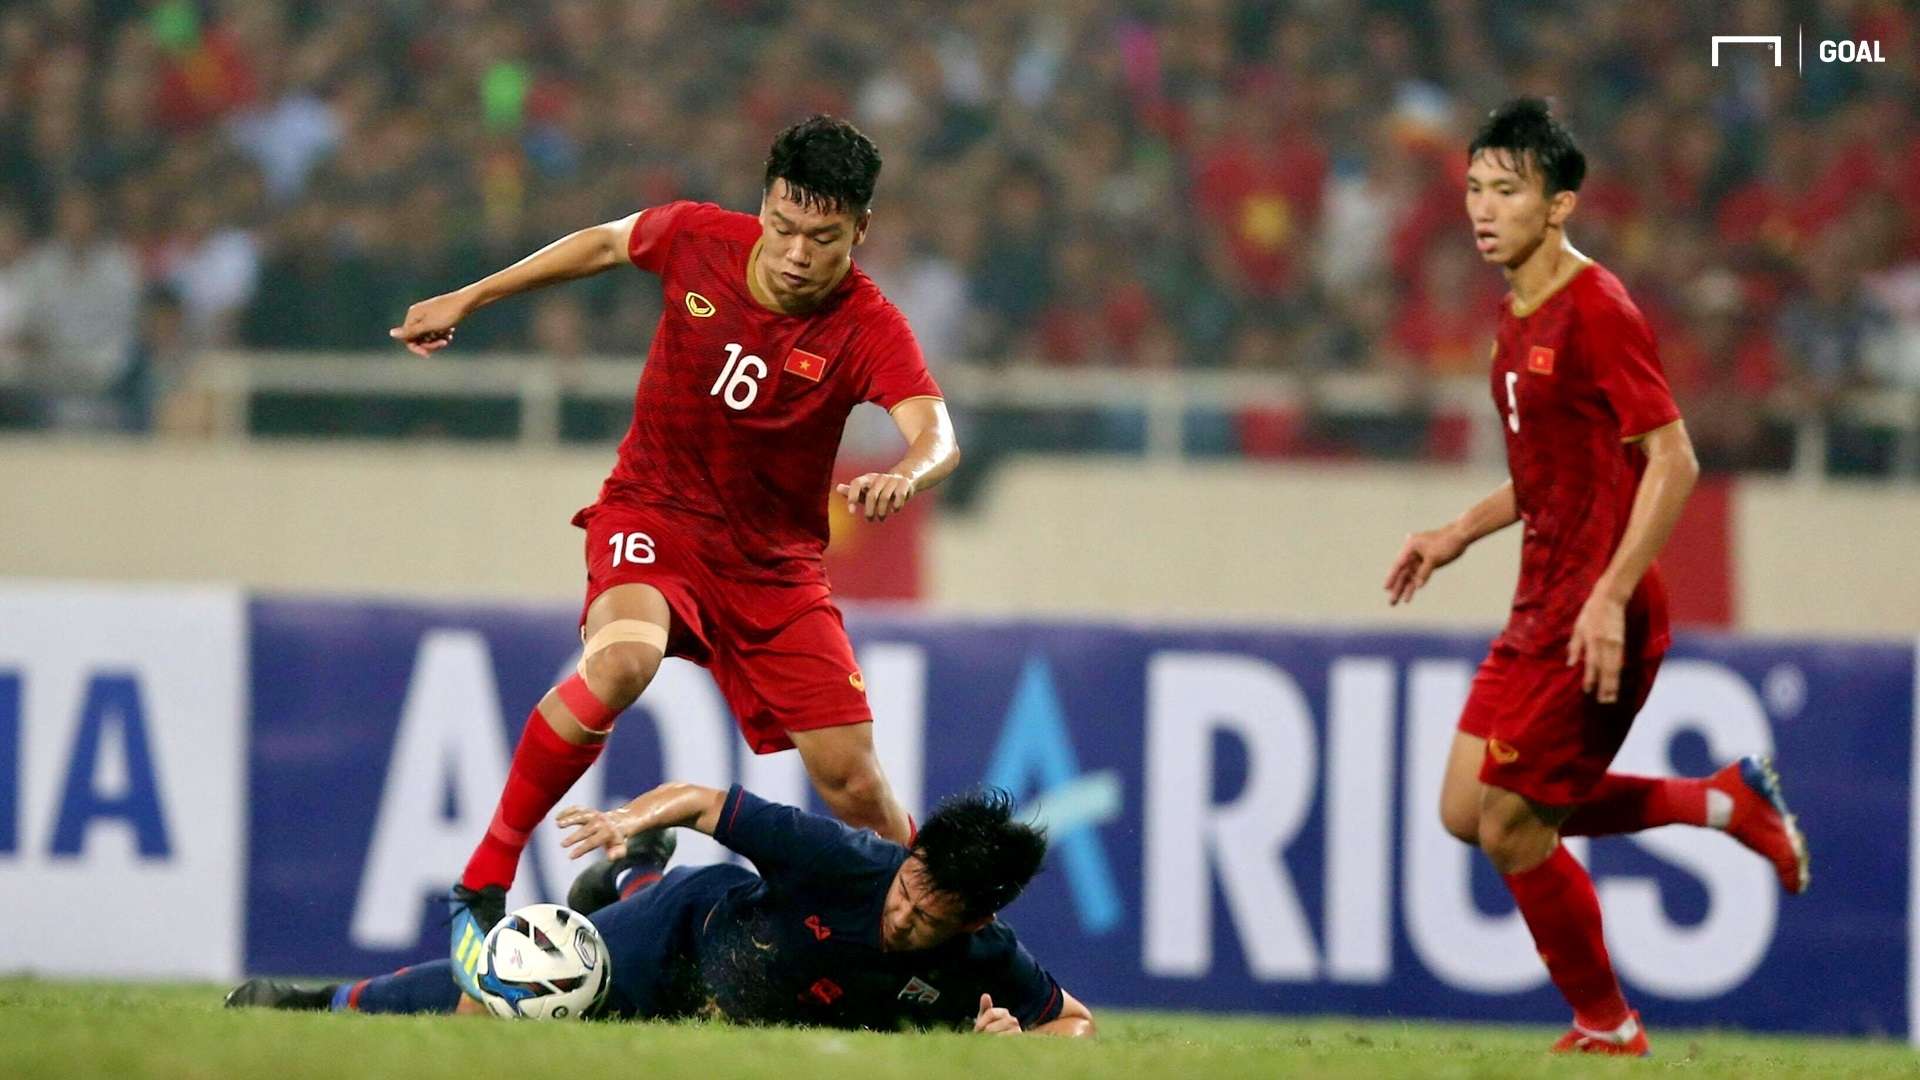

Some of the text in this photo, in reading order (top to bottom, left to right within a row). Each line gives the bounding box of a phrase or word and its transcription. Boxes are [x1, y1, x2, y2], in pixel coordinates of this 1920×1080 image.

[710, 342, 768, 411] 16
[1505, 371, 1520, 434] 5
[608, 532, 656, 567] 16
[0, 669, 174, 860] A
